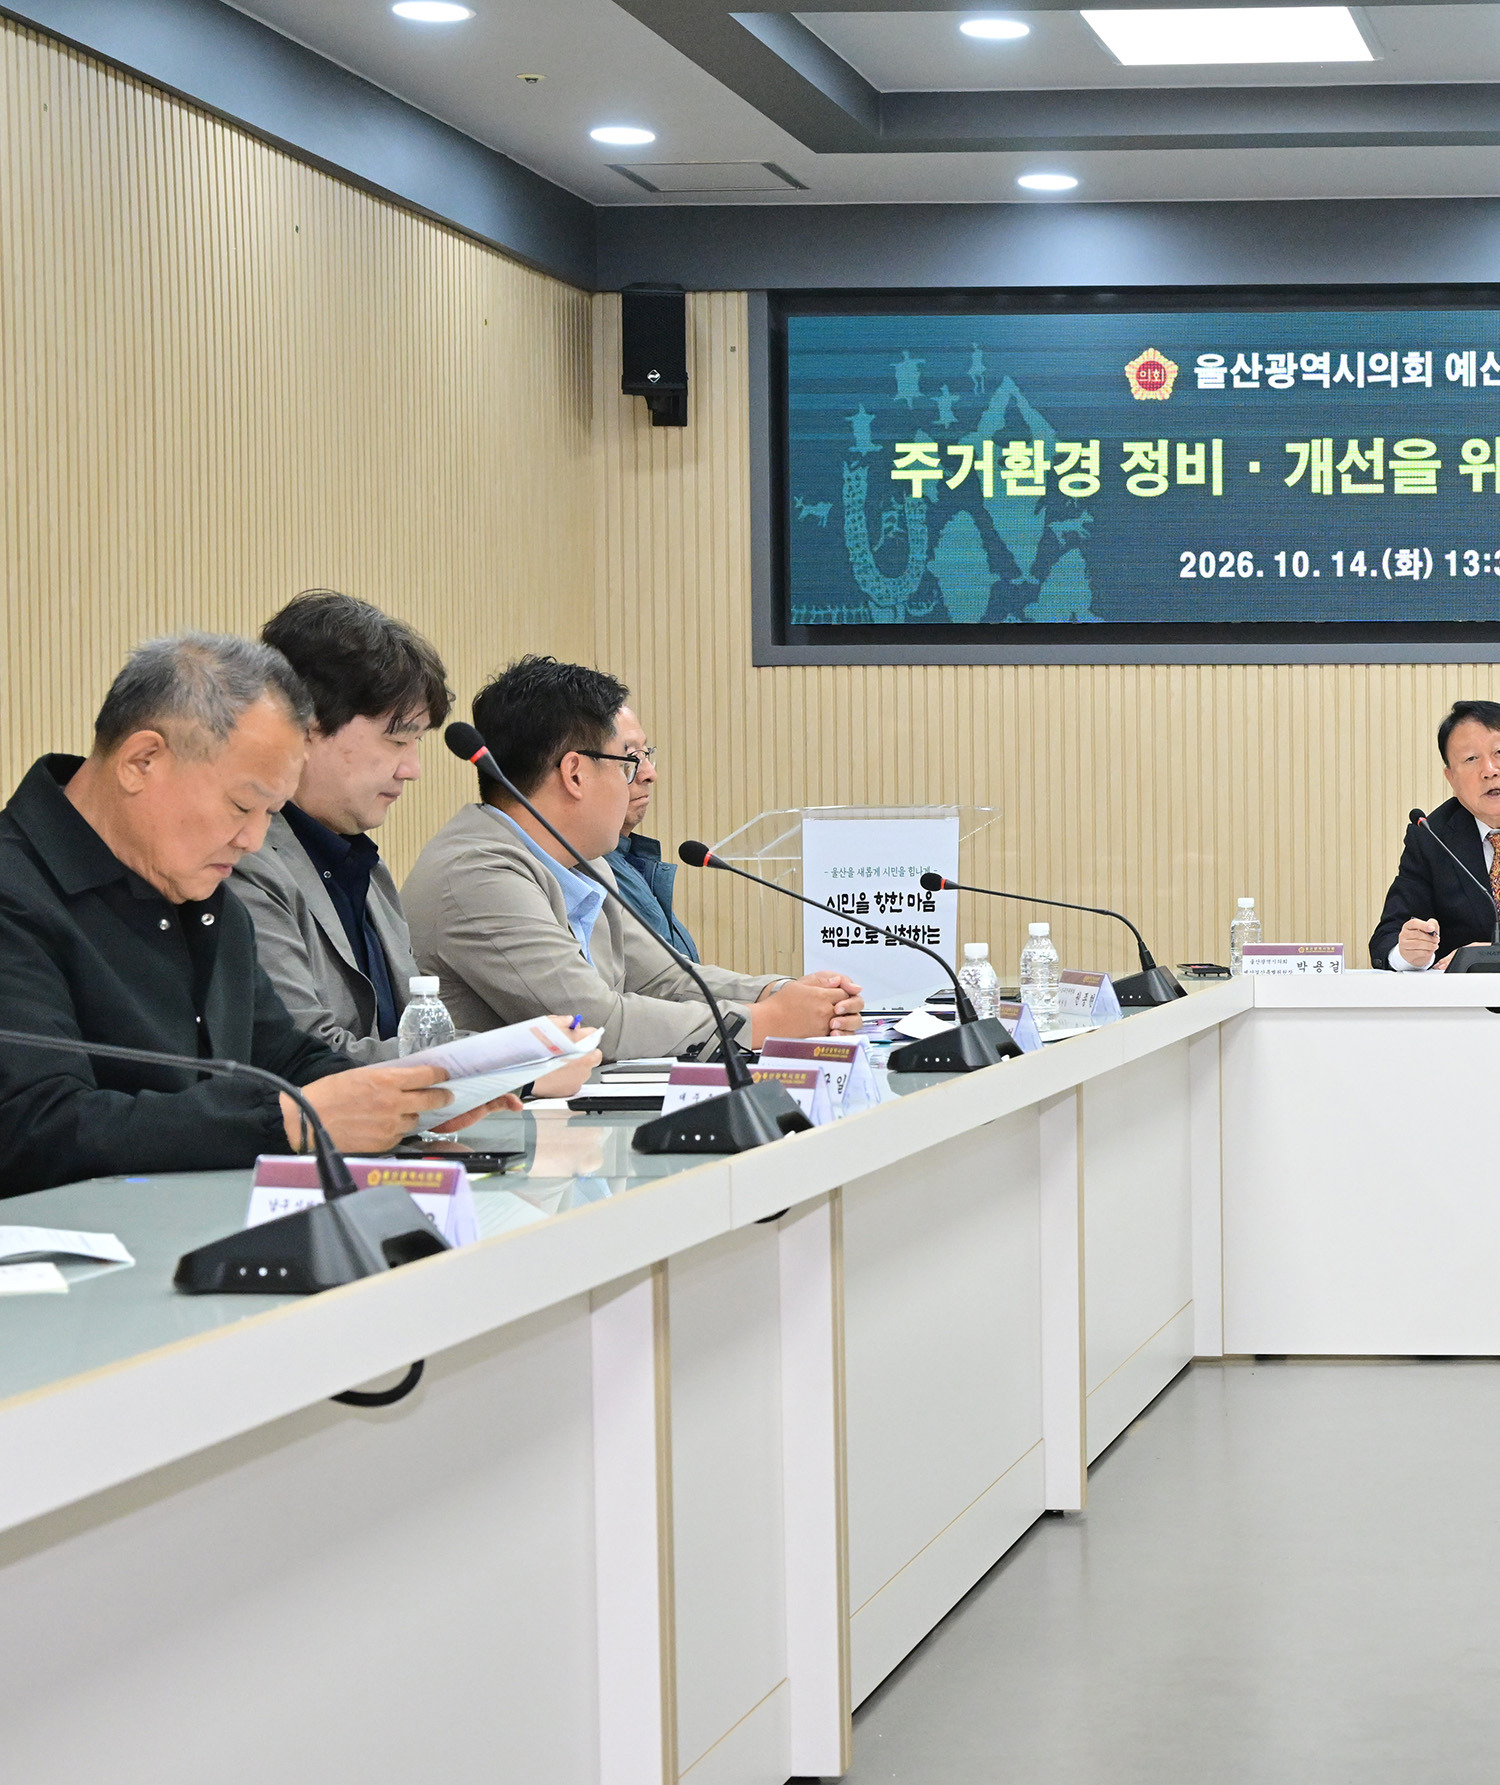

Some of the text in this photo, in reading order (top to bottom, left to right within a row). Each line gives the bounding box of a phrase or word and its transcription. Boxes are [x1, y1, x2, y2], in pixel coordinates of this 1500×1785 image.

[1138, 368, 1165, 382] 의회
[1194, 350, 1433, 389] 울산광역시의회
[890, 439, 1101, 499] 주거환경
[1120, 438, 1223, 497] 정비
[1284, 437, 1442, 495] 개선을
[1179, 551, 1264, 578] 2026.
[1274, 551, 1320, 578] 10.
[1331, 547, 1433, 581] 14.(화)
[830, 866, 855, 878] 울산을
[857, 866, 881, 878] 새롭게
[883, 866, 906, 878] 시민을
[826, 890, 936, 914] 시민을 향한 마음
[820, 925, 879, 948] 책임으로
